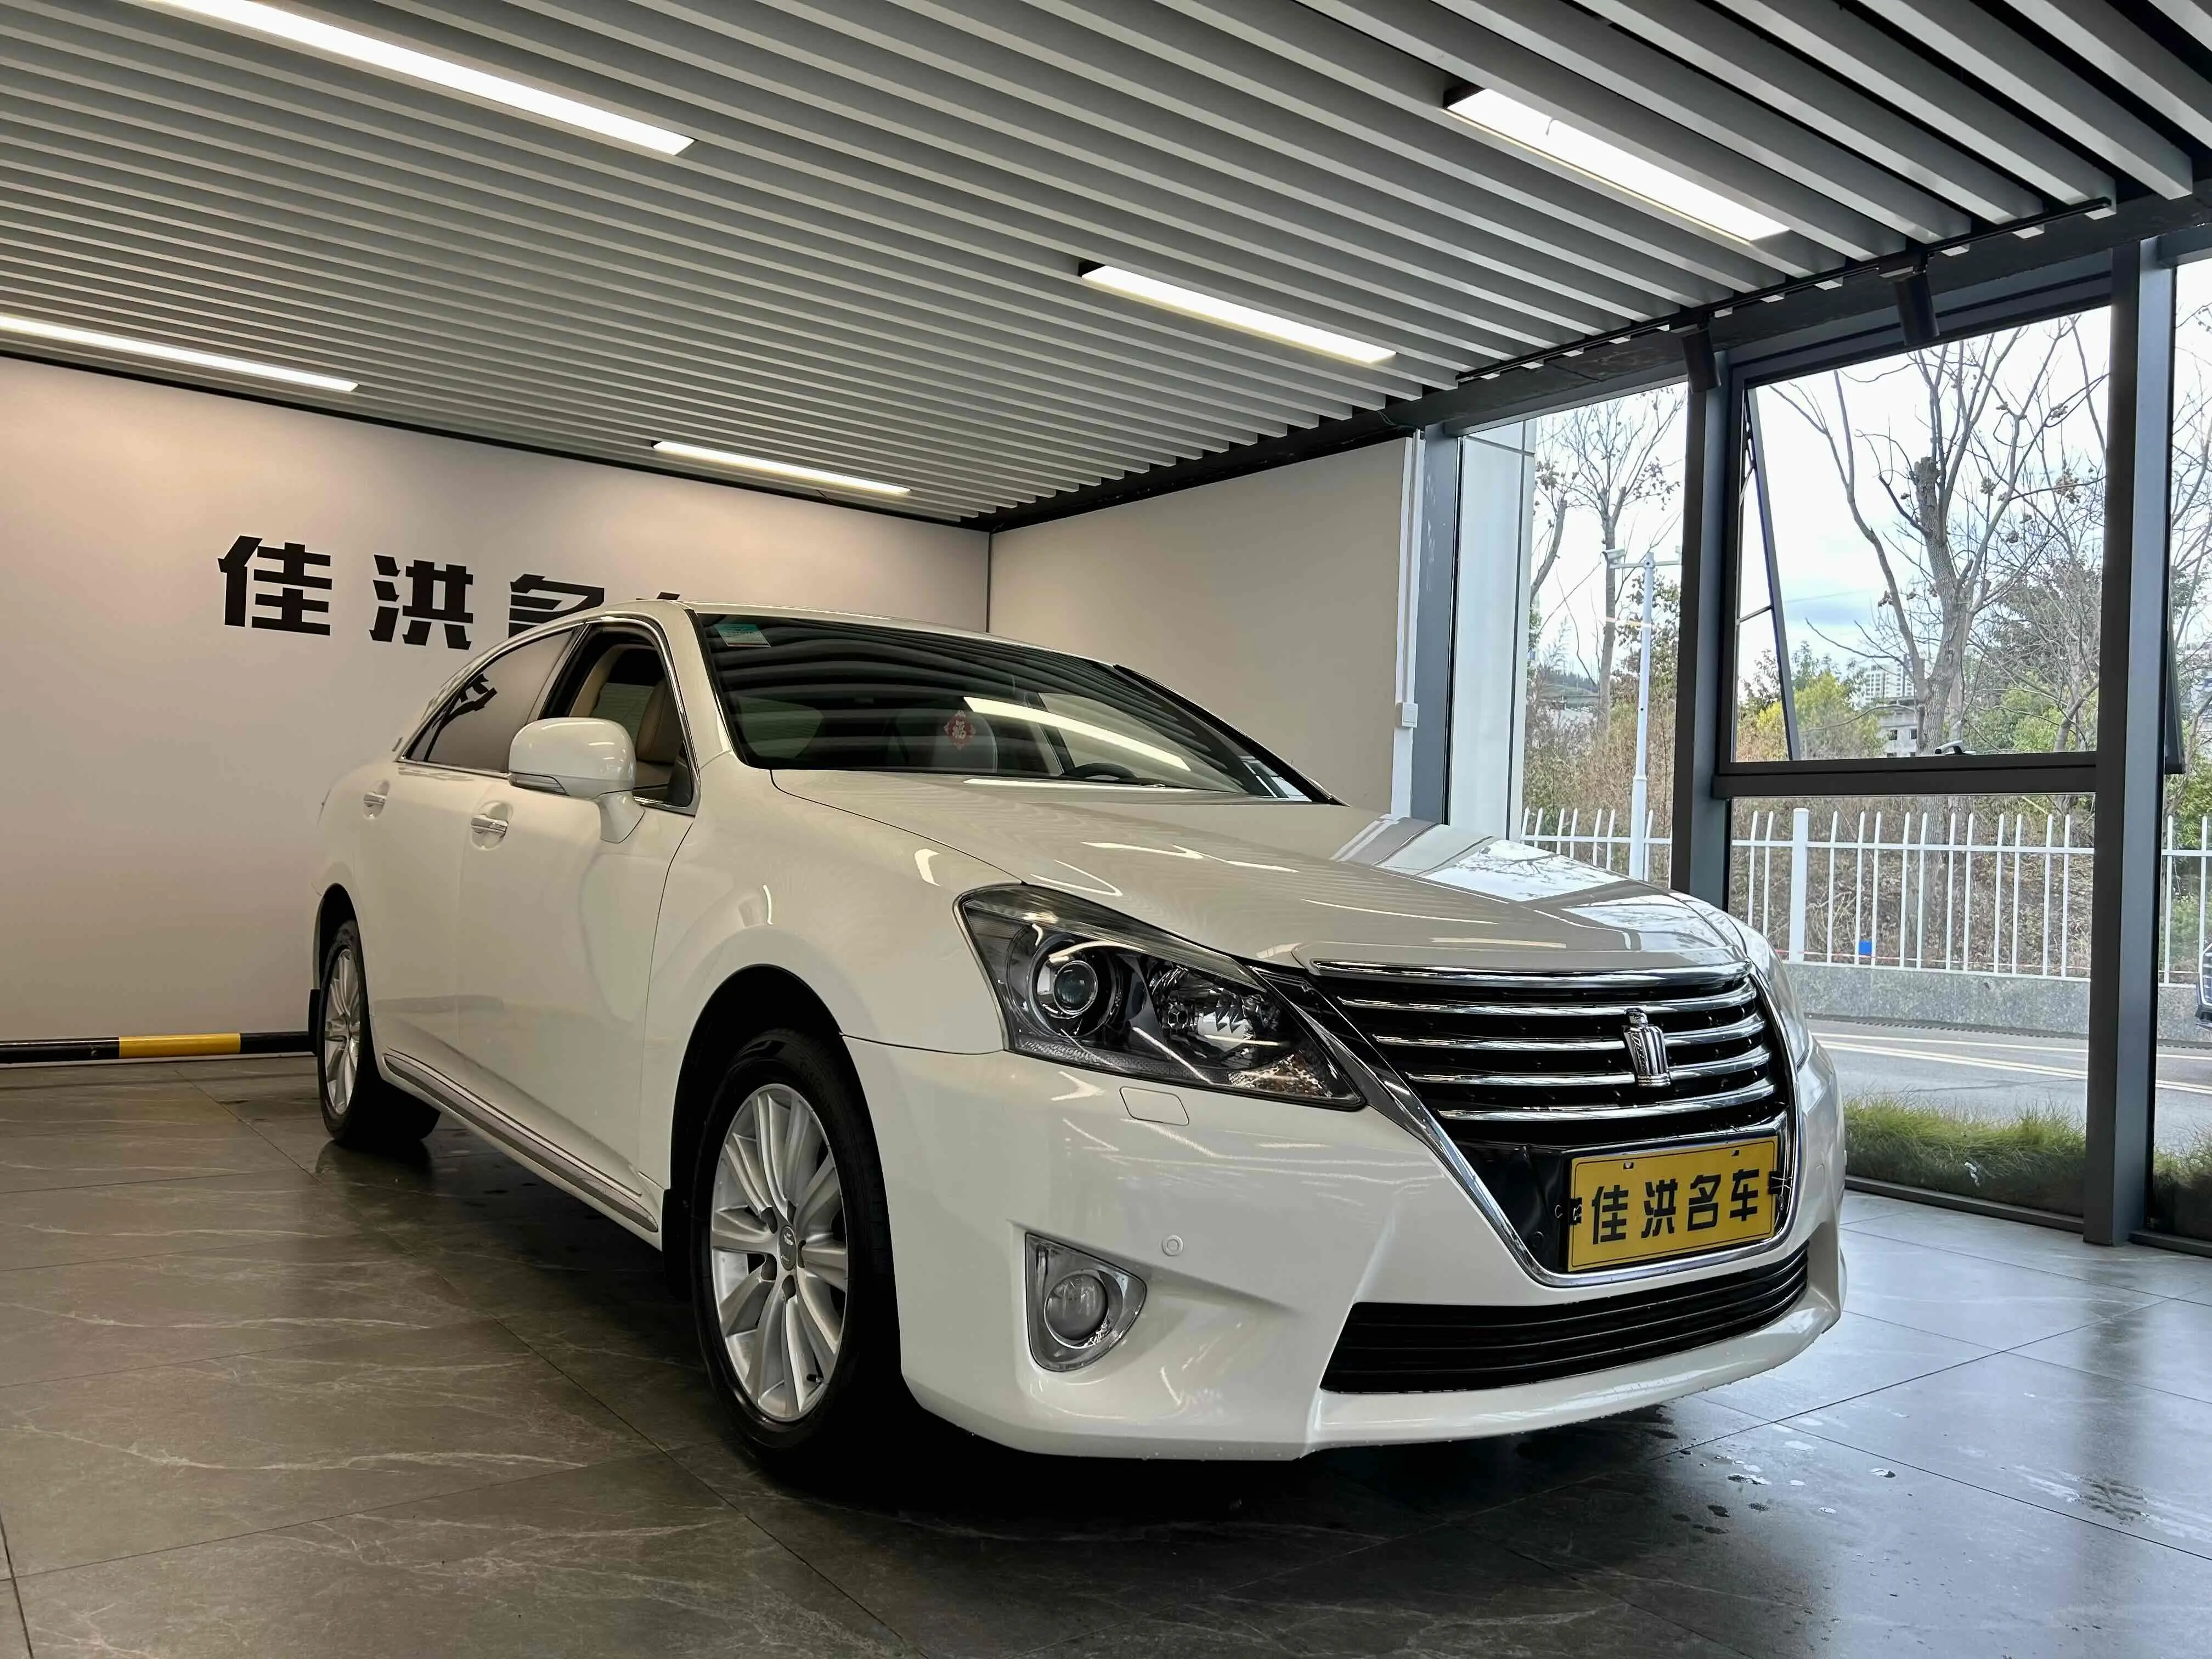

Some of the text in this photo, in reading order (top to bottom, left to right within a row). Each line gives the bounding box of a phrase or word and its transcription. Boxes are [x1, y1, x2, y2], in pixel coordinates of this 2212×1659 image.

[218, 535, 680, 650] 佳洪名
[1592, 1169, 1759, 1244] 佳洪名车
